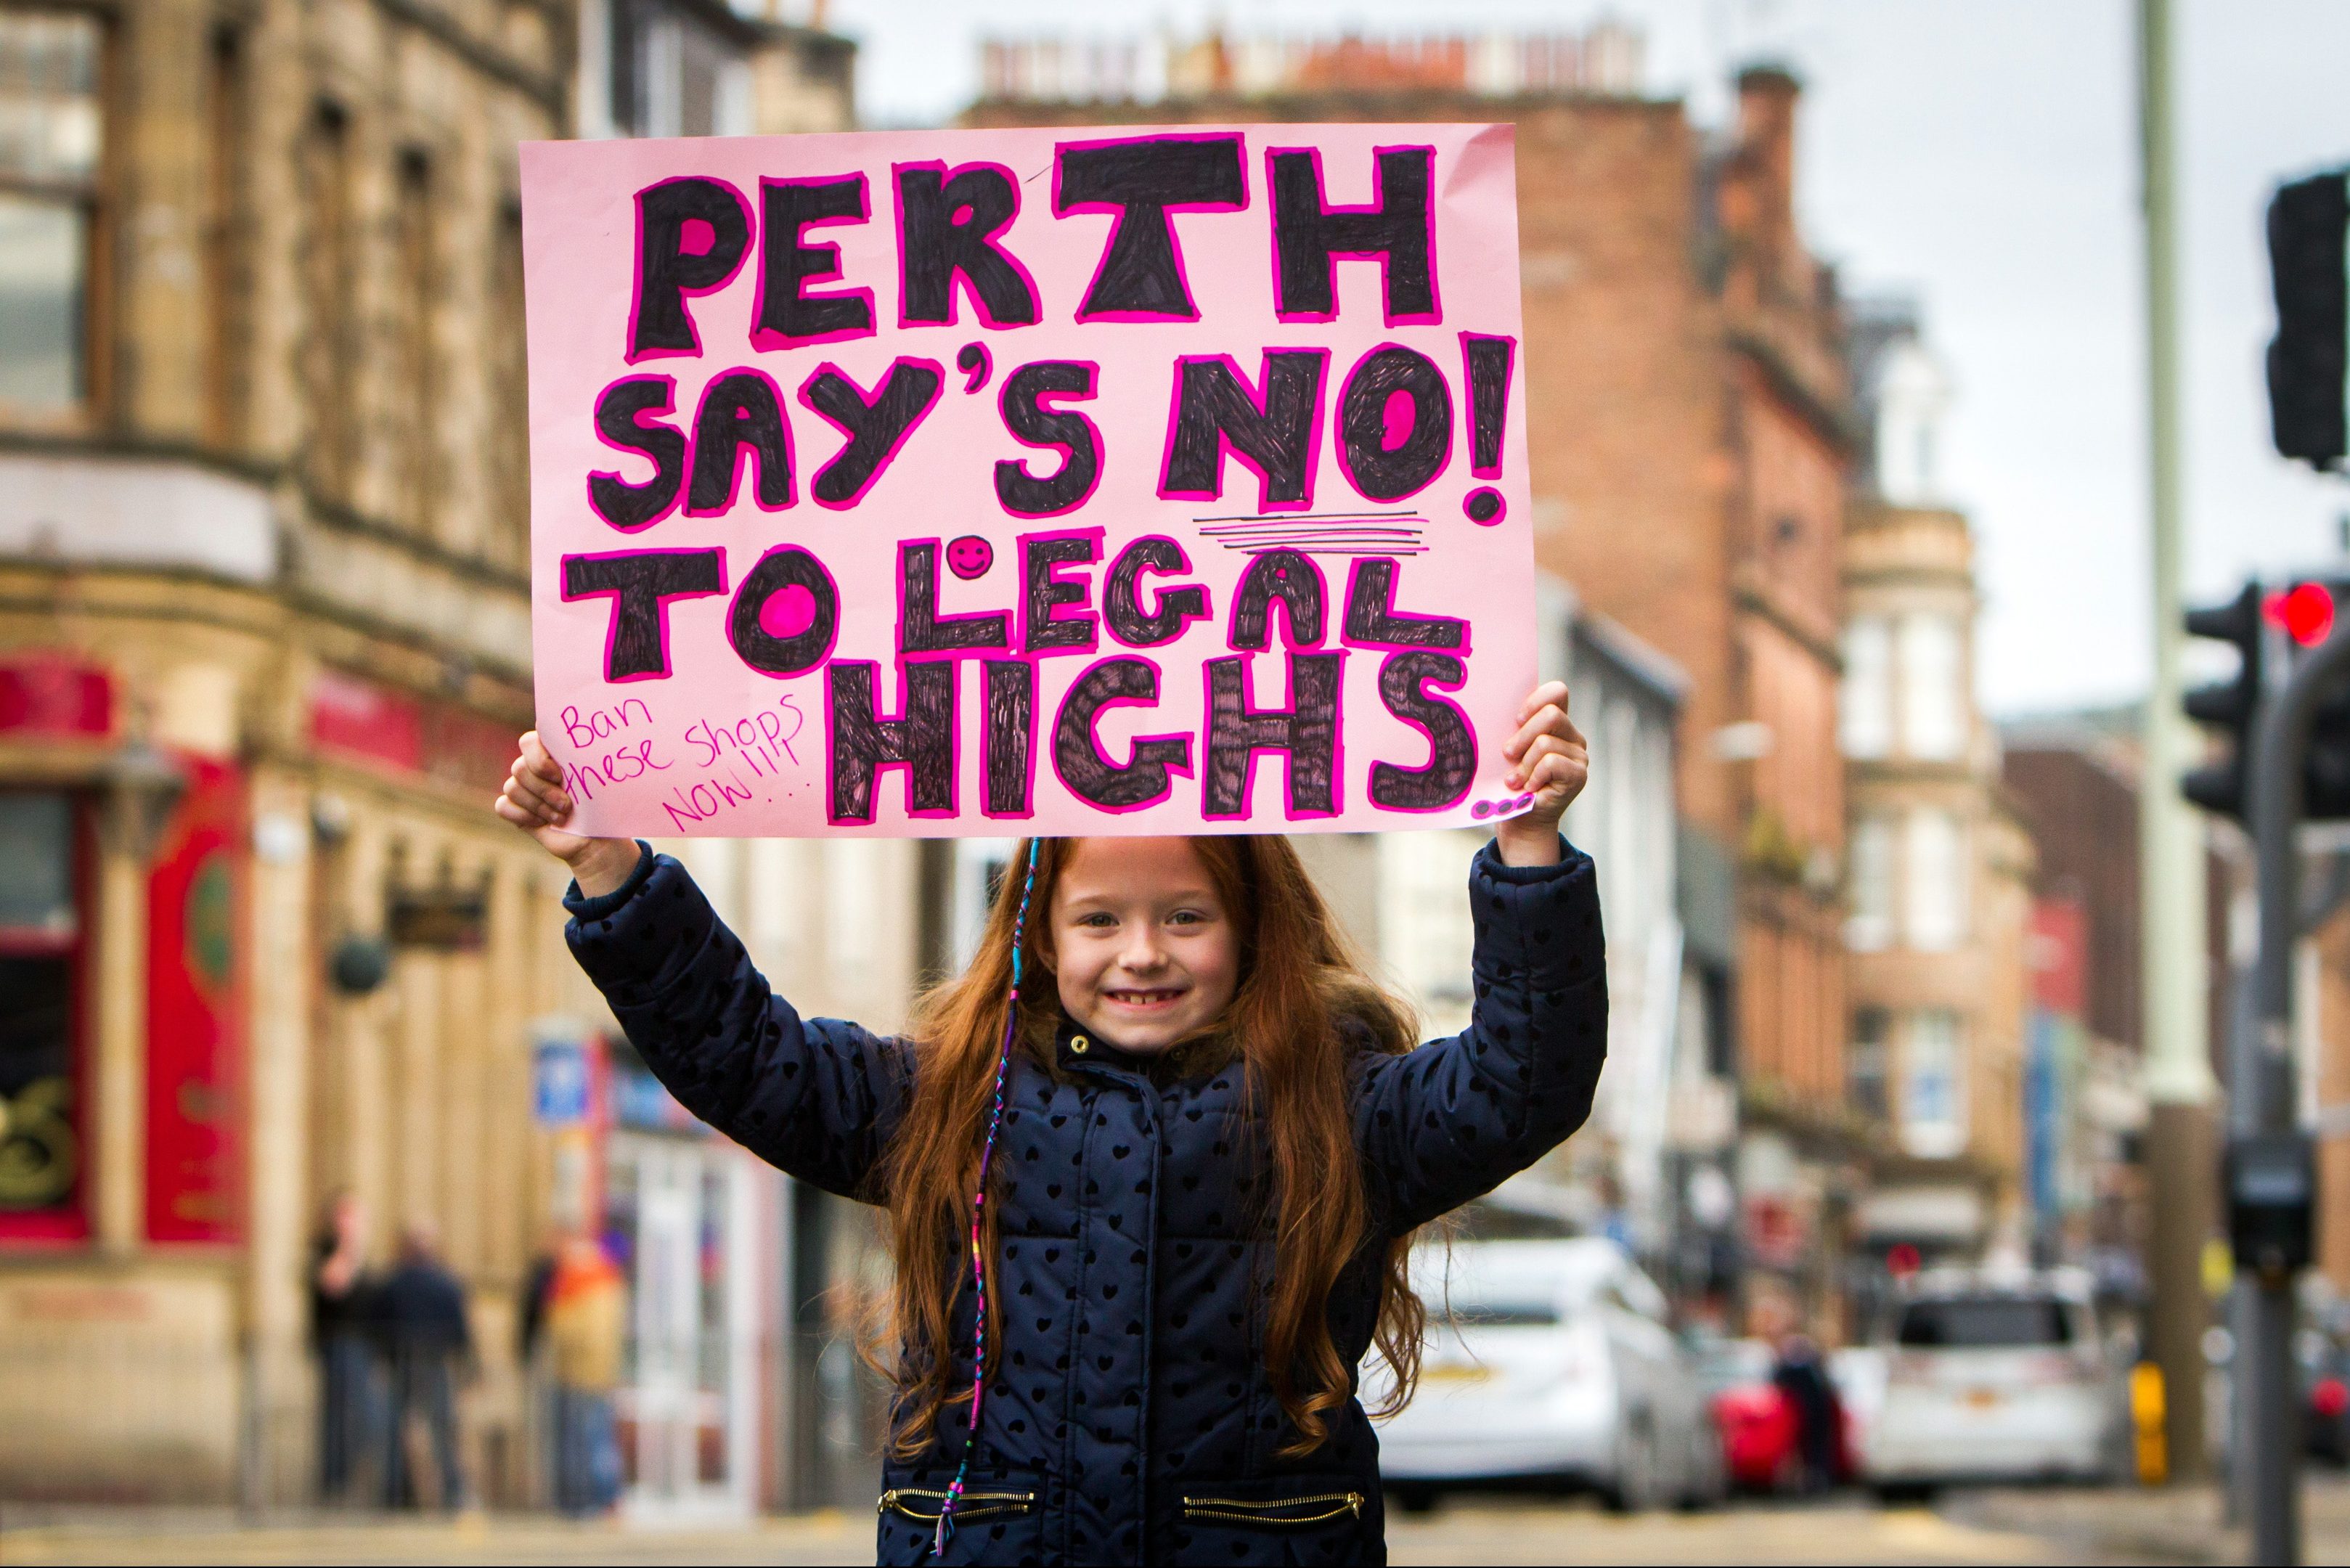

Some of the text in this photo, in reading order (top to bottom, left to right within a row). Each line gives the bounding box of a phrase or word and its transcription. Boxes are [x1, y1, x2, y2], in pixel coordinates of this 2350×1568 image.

[624, 131, 1443, 366] PERTH
[587, 330, 1517, 534] SAY'S NO!
[560, 526, 1472, 684] TO LEGAL
[560, 698, 653, 748] Ban
